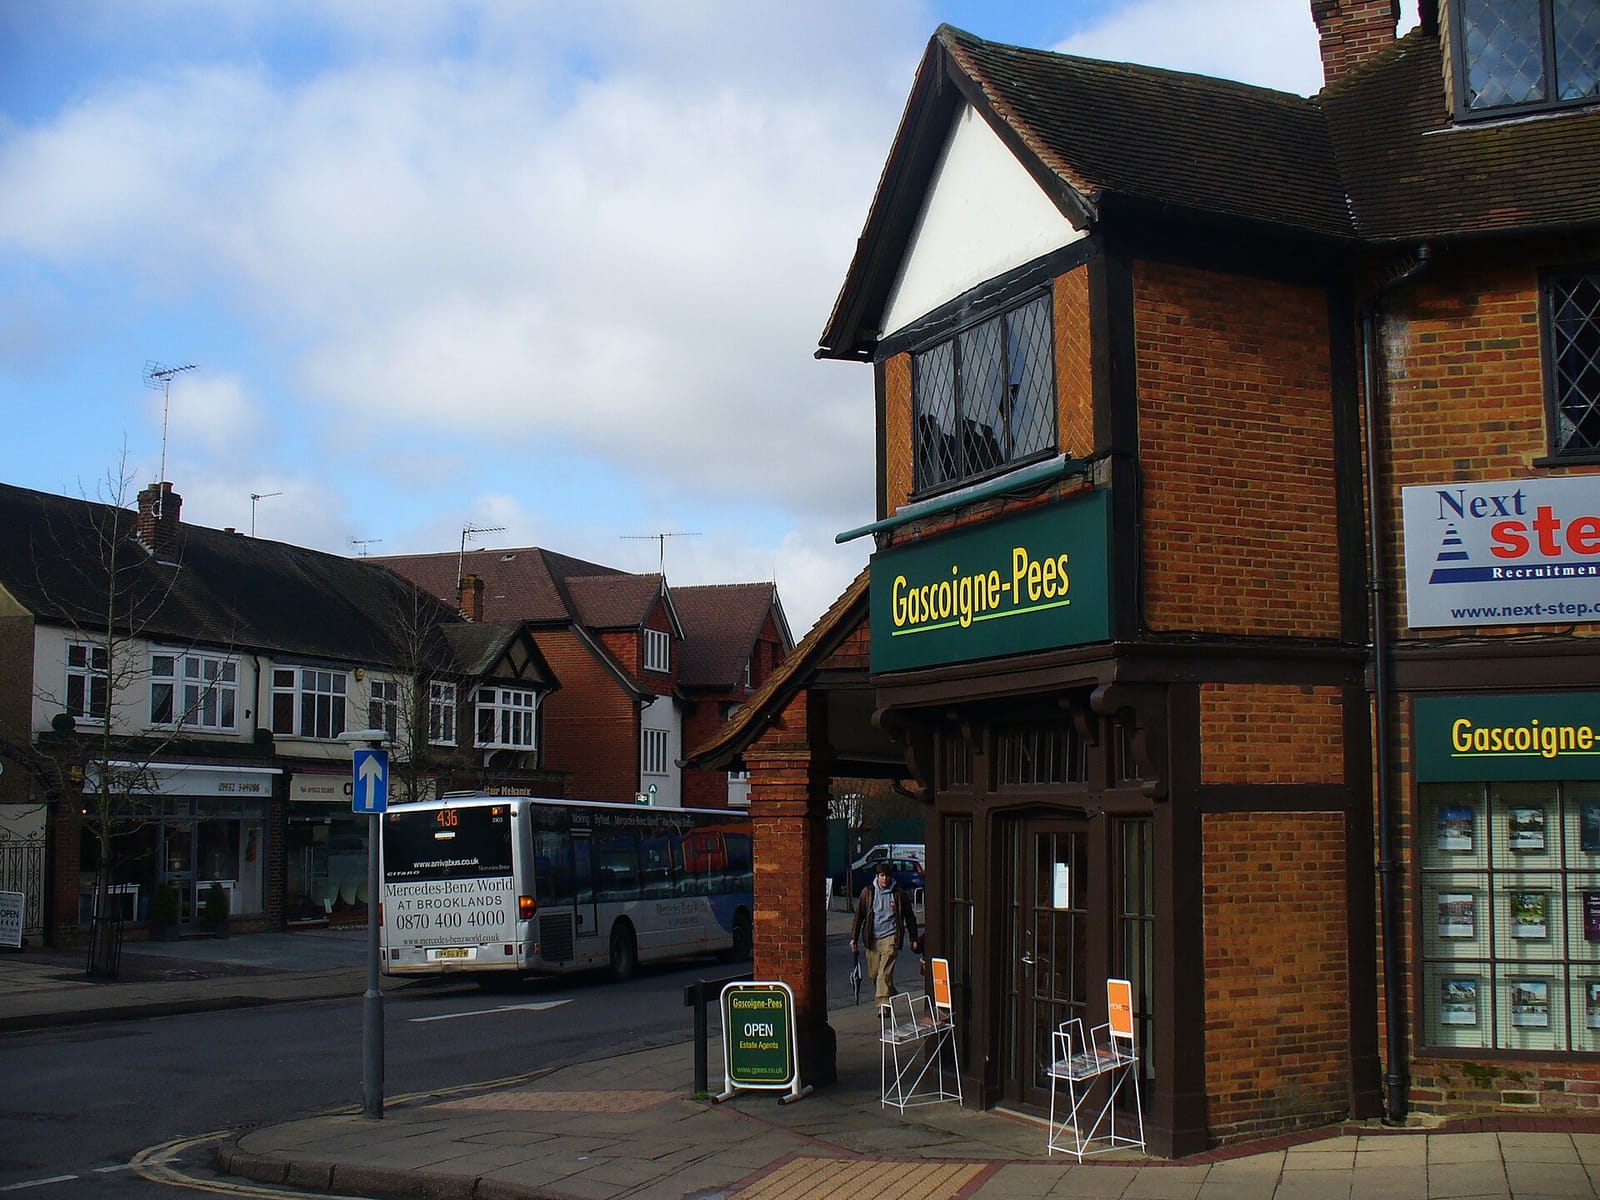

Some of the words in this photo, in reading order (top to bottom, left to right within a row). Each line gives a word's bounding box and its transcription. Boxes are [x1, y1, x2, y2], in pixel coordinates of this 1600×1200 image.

[1436, 488, 1527, 521] Next
[1489, 506, 1600, 559] ste
[1492, 564, 1600, 579] Recruitmen
[891, 546, 1070, 628] Gascoigne-Pees
[436, 809, 459, 827] 436
[413, 857, 479, 869] www.arrivabus.co.uk
[385, 881, 474, 897] Mercedes-Benz
[477, 878, 513, 892] World
[397, 900, 412, 910] AT
[417, 896, 502, 910] BROOKLANDS
[396, 914, 429, 930] 0870
[435, 912, 462, 928] 400
[468, 910, 505, 926] 4000
[733, 998, 782, 1010] Gascoigne-Pees
[744, 1023, 774, 1037] OPEN
[739, 1041, 758, 1049] Estate
[758, 1041, 779, 1051] Agents
